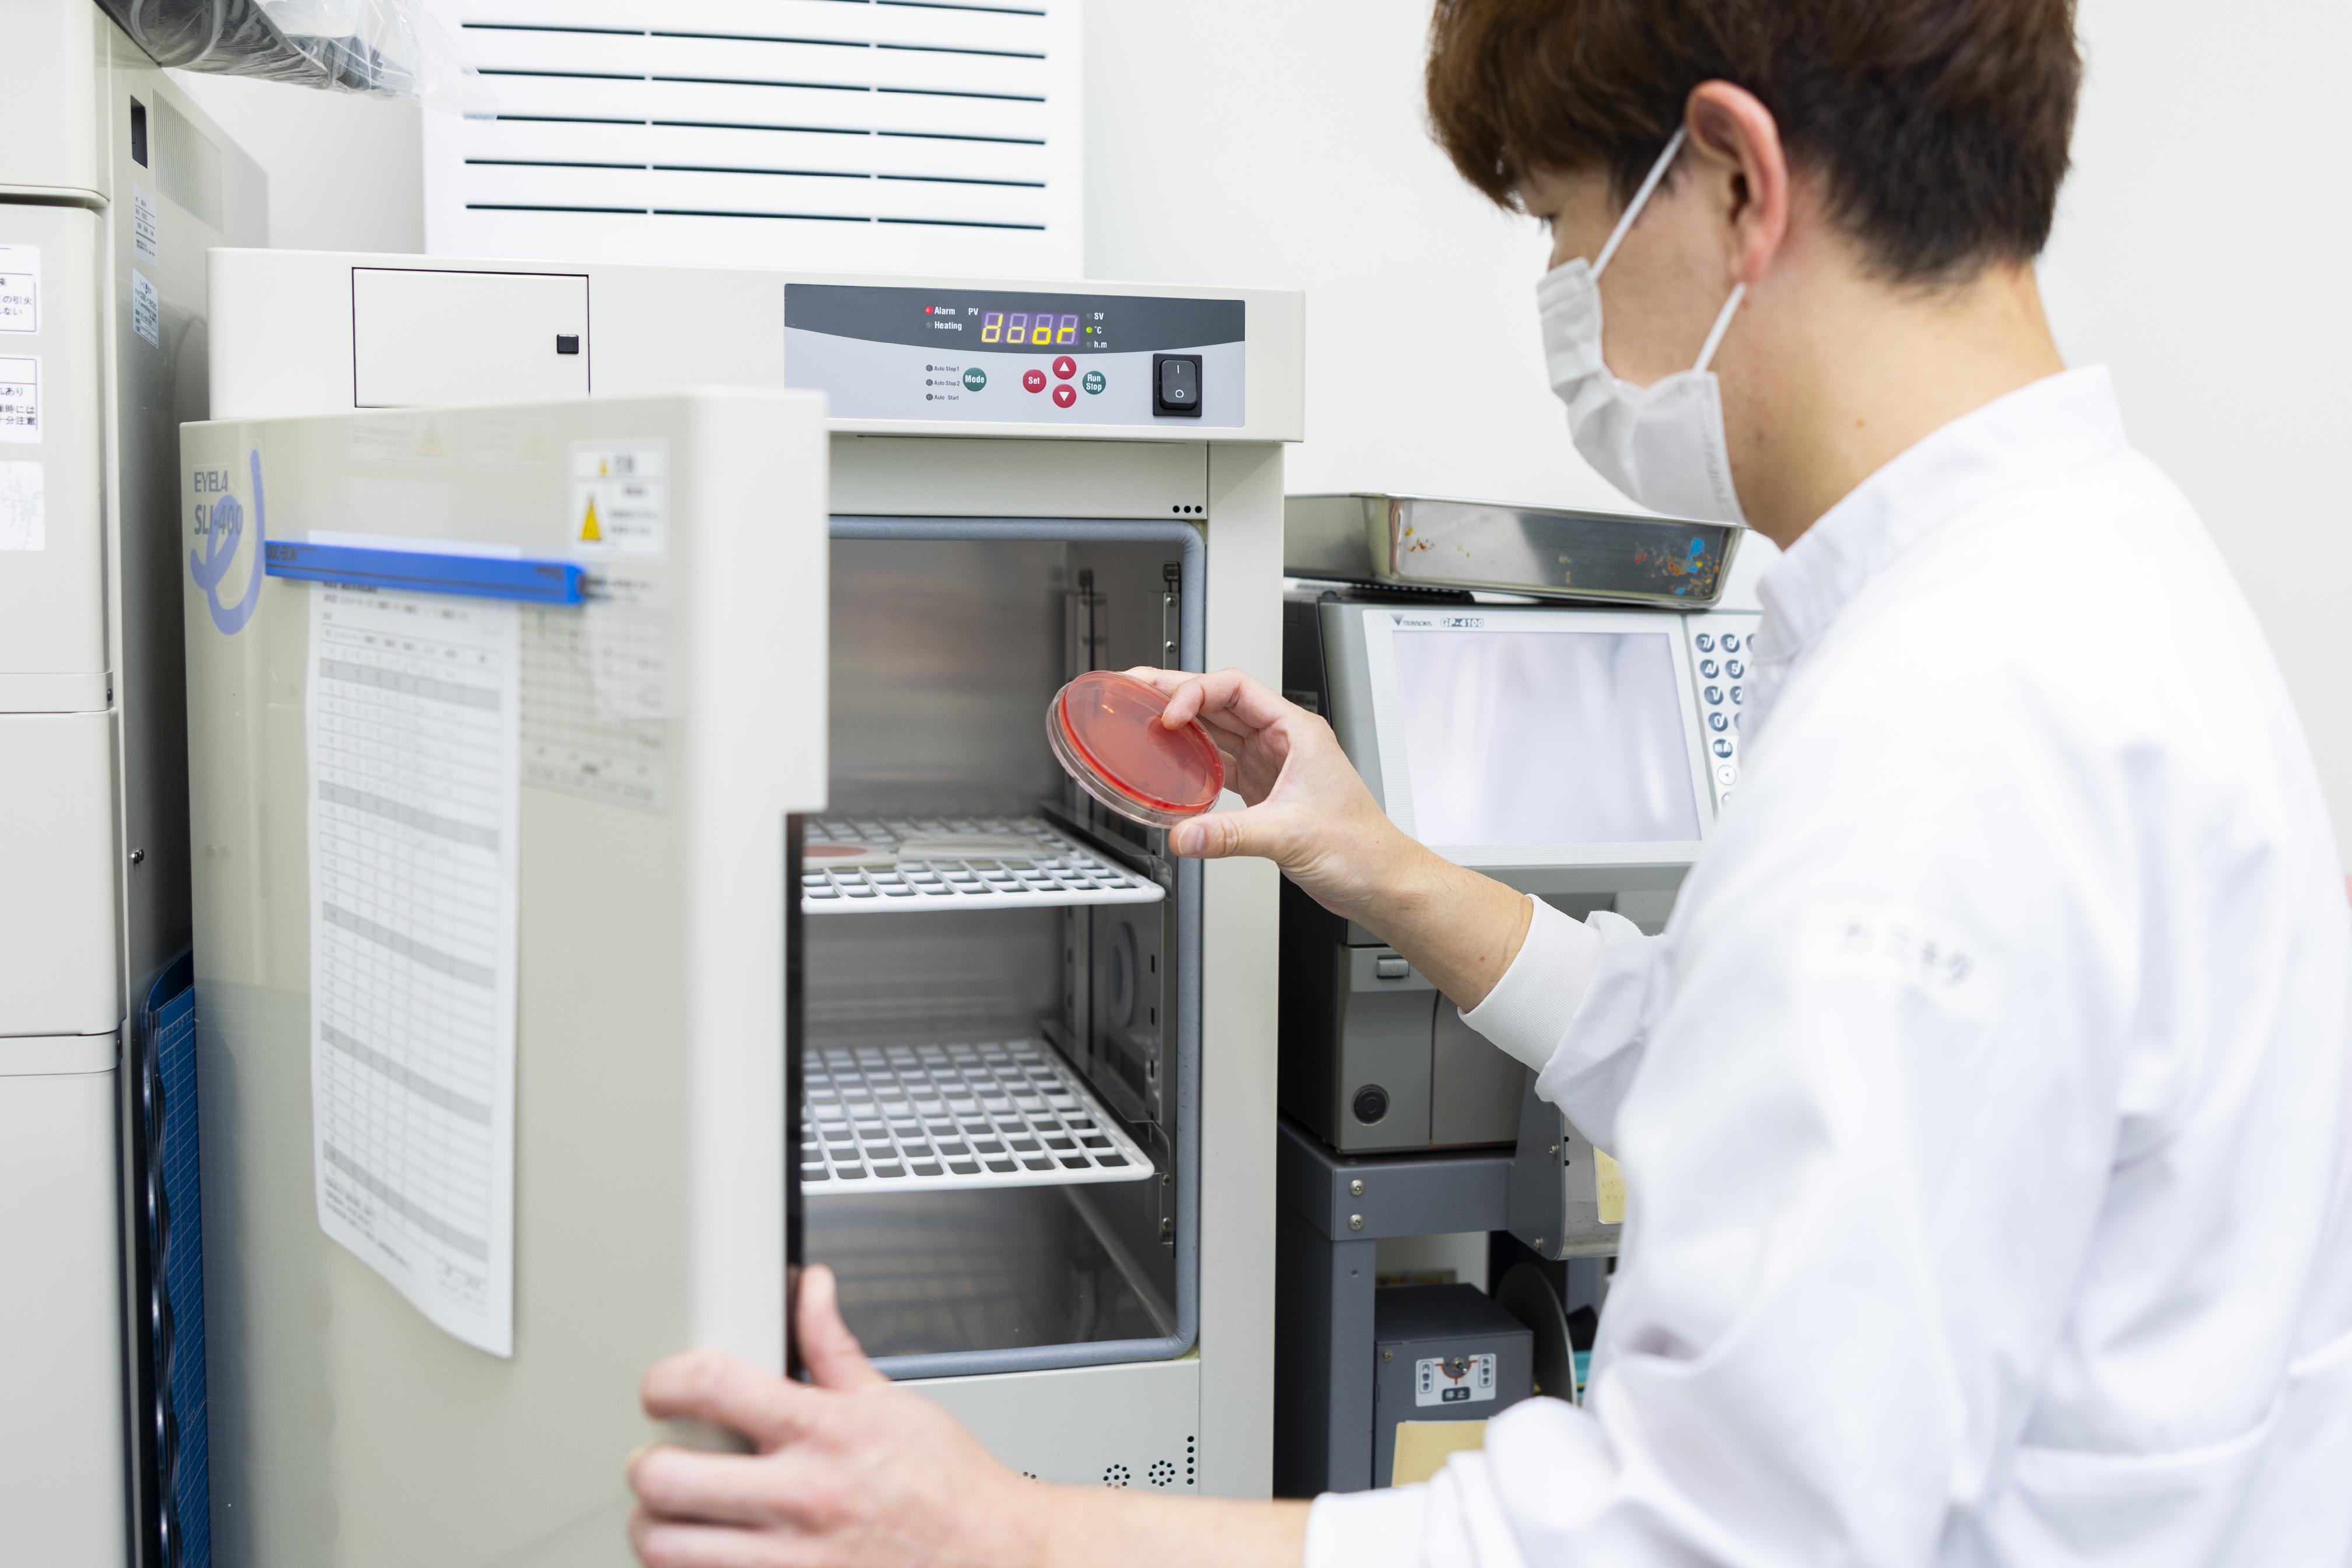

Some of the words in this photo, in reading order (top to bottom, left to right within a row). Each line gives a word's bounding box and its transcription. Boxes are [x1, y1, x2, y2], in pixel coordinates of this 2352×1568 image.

[0, 295, 33, 304] の引火
[935, 307, 955, 315] Alarm
[935, 322, 962, 331] Heating
[965, 374, 985, 383] Mode
[1087, 374, 1101, 382] Run
[1086, 383, 1102, 391] Stop
[194, 471, 228, 492] EYELA
[194, 504, 244, 535] SLI-400
[1441, 618, 1483, 627] GP-4100
